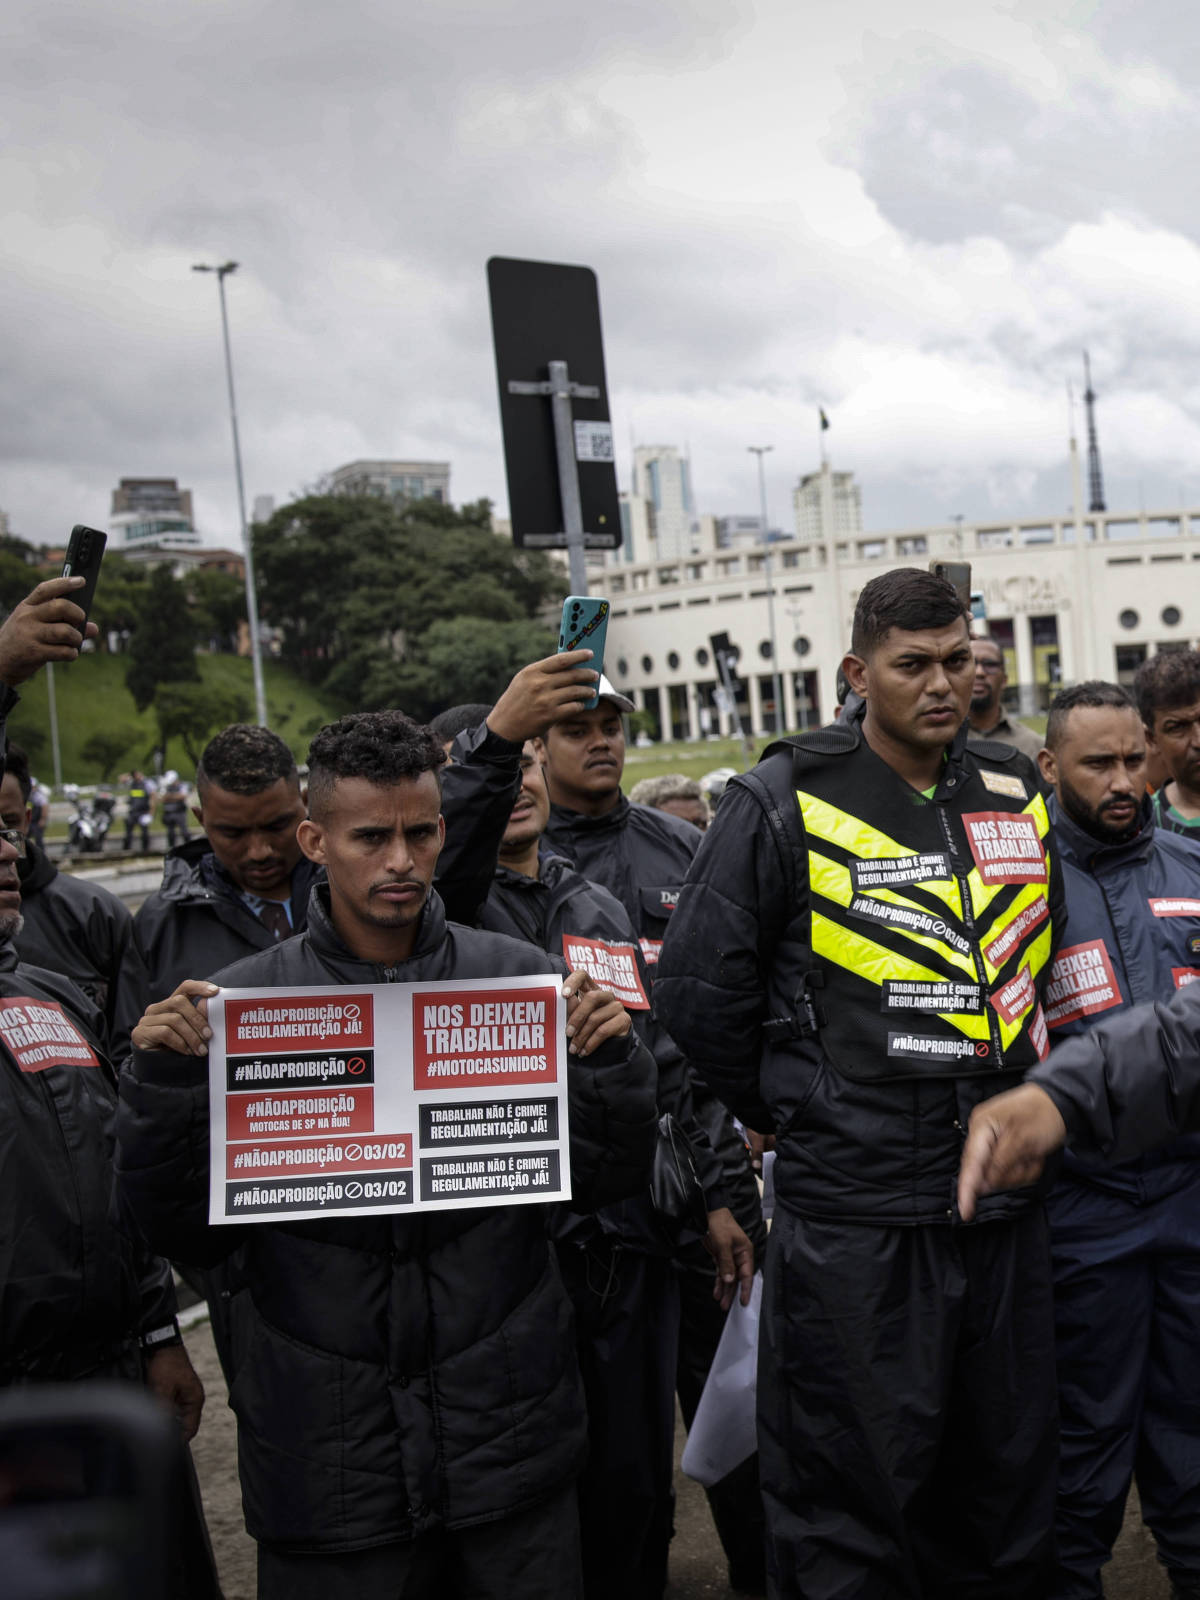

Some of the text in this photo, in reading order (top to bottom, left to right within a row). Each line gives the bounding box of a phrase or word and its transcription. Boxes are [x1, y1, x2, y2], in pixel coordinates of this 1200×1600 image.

[970, 821, 1036, 840] NOS DEIXEM
[974, 839, 1042, 860] TRABALHAR
[856, 855, 945, 873] TRABALHAR NÃO É CRIME!
[857, 864, 947, 885] REGULAMENTAÇÃO JÁ!
[984, 862, 1046, 877] #MOTOCASUNIDOS
[853, 898, 933, 931] #NÃOAPROIBIÇÃO
[944, 927, 970, 952] 03/02
[568, 945, 595, 962] NOS
[595, 948, 634, 972] DEIXEM
[889, 982, 980, 997] TRABALHAR NÃO É CRIME!
[240, 1004, 343, 1023] #NÃOAPROIBIÇÃO
[888, 995, 980, 1012] REGULAMENTAÇÃO JÁ!
[24, 1006, 69, 1026] DEIXEM
[424, 1001, 545, 1028] NOS DEIXEM
[1, 1023, 82, 1048] TRABALHAR
[238, 1019, 363, 1040] REGULAMENTAÇÃO JÁ!
[424, 1024, 545, 1054] TRABALHAR
[892, 1036, 975, 1059] #NÃOAPROIBIÇÃO
[235, 1057, 346, 1081] #NÃOAPROIBIÇÃO
[427, 1055, 547, 1077] #MOTOCASUNIDOS
[246, 1093, 355, 1117] #NÃOAPROIBIÇÃO
[430, 1104, 547, 1123] TRABALHAR NÃO É CRIME!
[249, 1116, 350, 1133] MOTOCAS DE SP NA RUA!
[430, 1118, 548, 1139] REGULAMENTAÇÃO JÁ!
[234, 1143, 406, 1168] #NÃOAPROIBIÇÃO 03/02
[432, 1157, 549, 1176] TRABALHAR NÃO É CRIME!
[432, 1170, 550, 1193] REGULAMENTAÇÃO JÁ!
[233, 1180, 407, 1207] #NÃOAPROIBIÇÃO 03/02
